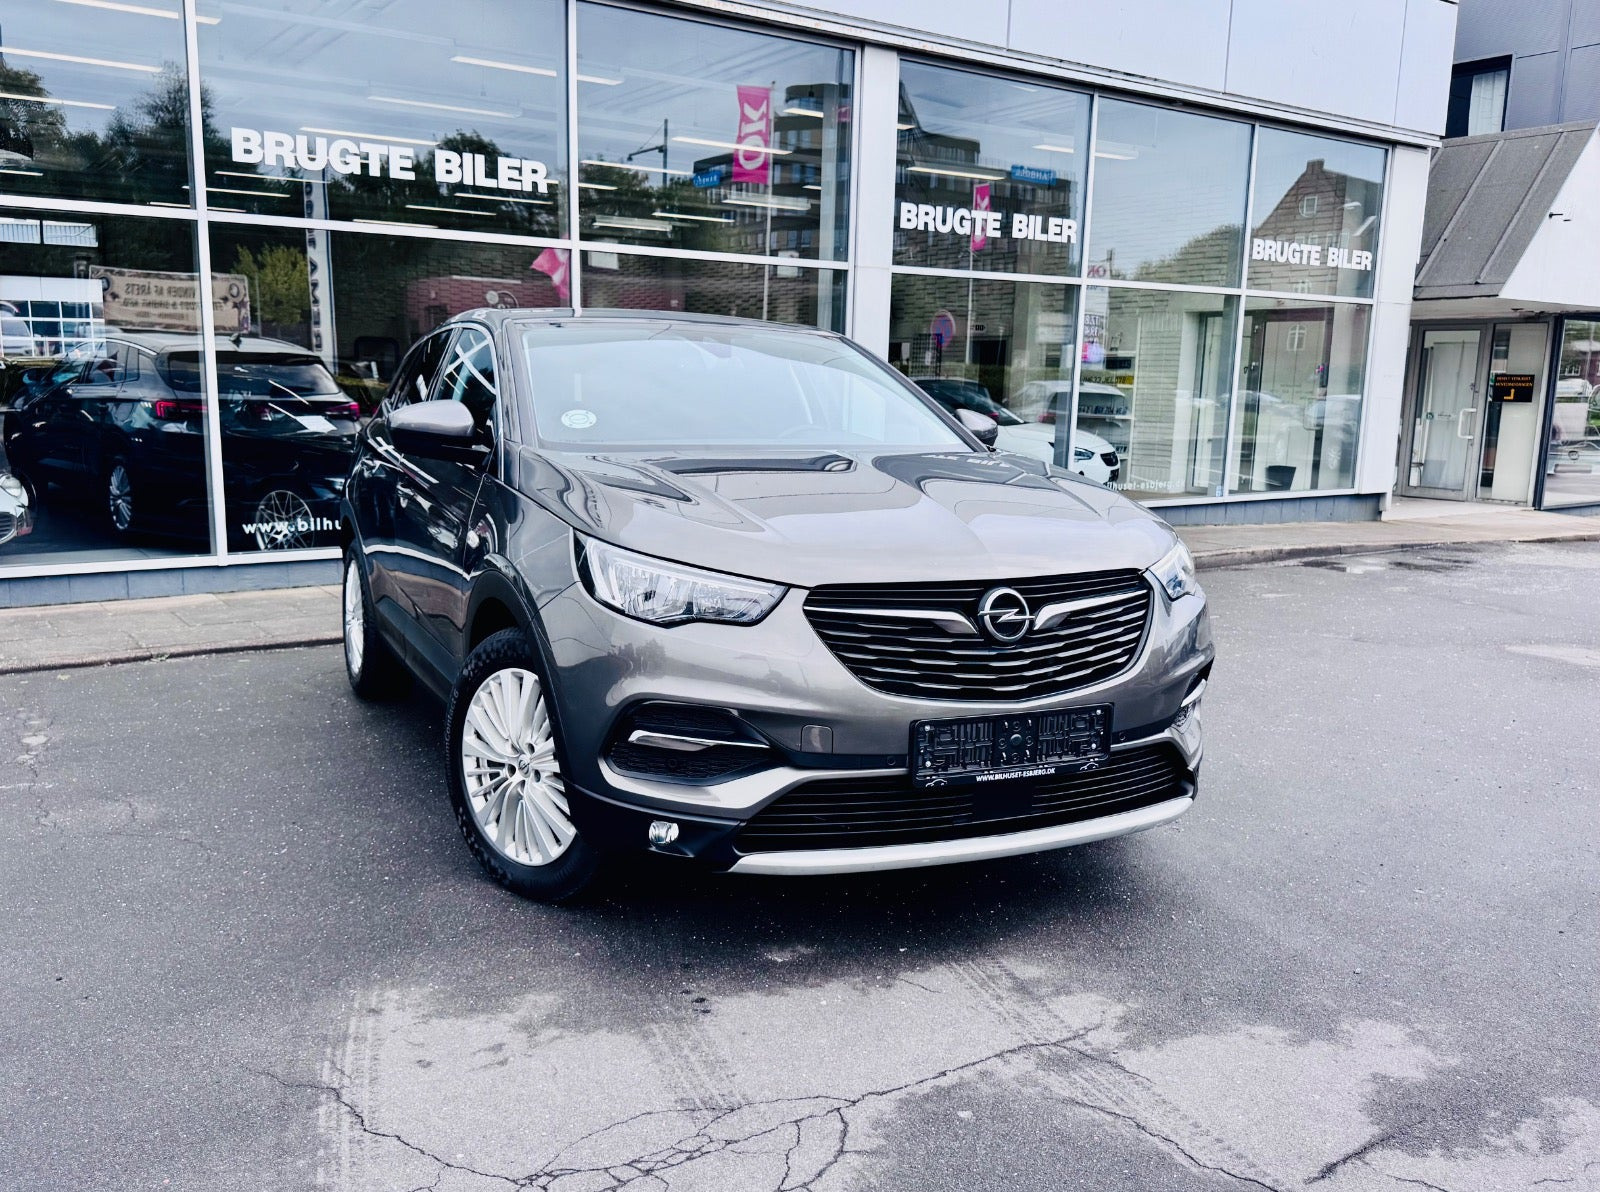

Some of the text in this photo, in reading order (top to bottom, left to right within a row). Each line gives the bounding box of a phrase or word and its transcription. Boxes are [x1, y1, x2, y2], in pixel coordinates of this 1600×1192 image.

[231, 127, 549, 194] BRUGTE BILER
[900, 202, 1078, 245] BRUGTE BILER
[1252, 238, 1372, 271] BRUGTE BILER
